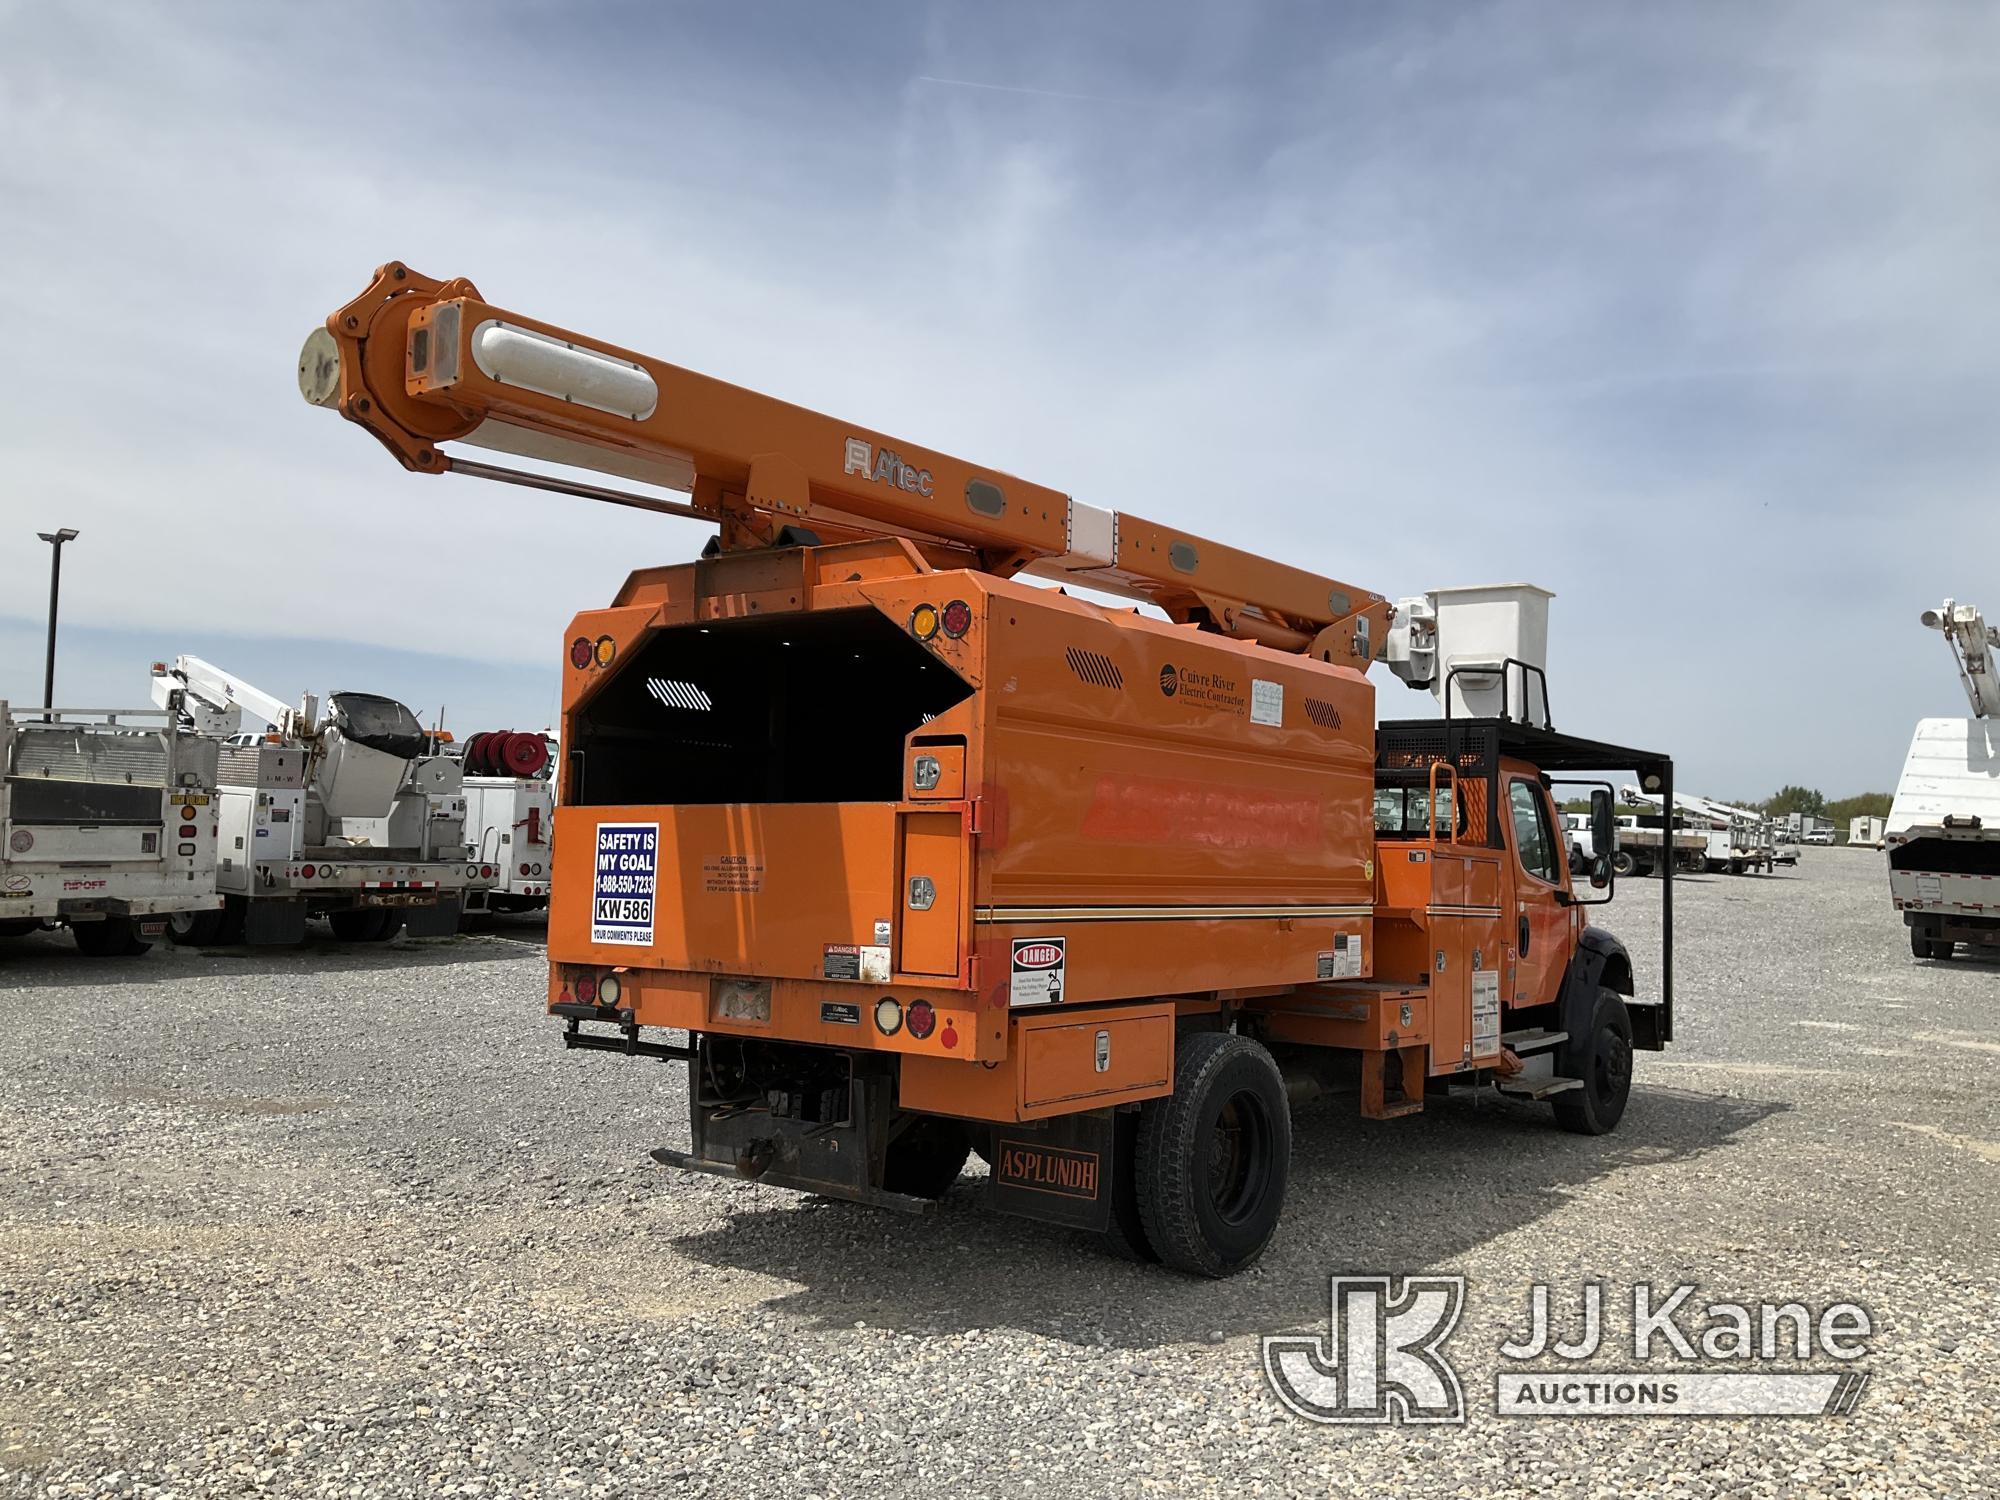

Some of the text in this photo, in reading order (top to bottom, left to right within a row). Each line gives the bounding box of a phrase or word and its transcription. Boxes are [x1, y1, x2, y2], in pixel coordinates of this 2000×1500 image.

[872, 448, 934, 497] Altec
[1180, 667, 1236, 692] Cuivre River
[1180, 684, 1245, 706] Electric Contractor
[600, 833, 655, 850] SAFETY IS
[599, 854, 653, 871] MY GOAL
[720, 855, 747, 864] CAUTION
[596, 875, 654, 894] 1-888-550-7233
[598, 899, 650, 920] KW 586
[594, 929, 652, 943] YOUR COMMENTS PLEASE
[833, 946, 857, 954] DANGER
[1022, 948, 1056, 963] DANGER
[1001, 1149, 1095, 1190] ASPLUNDH
